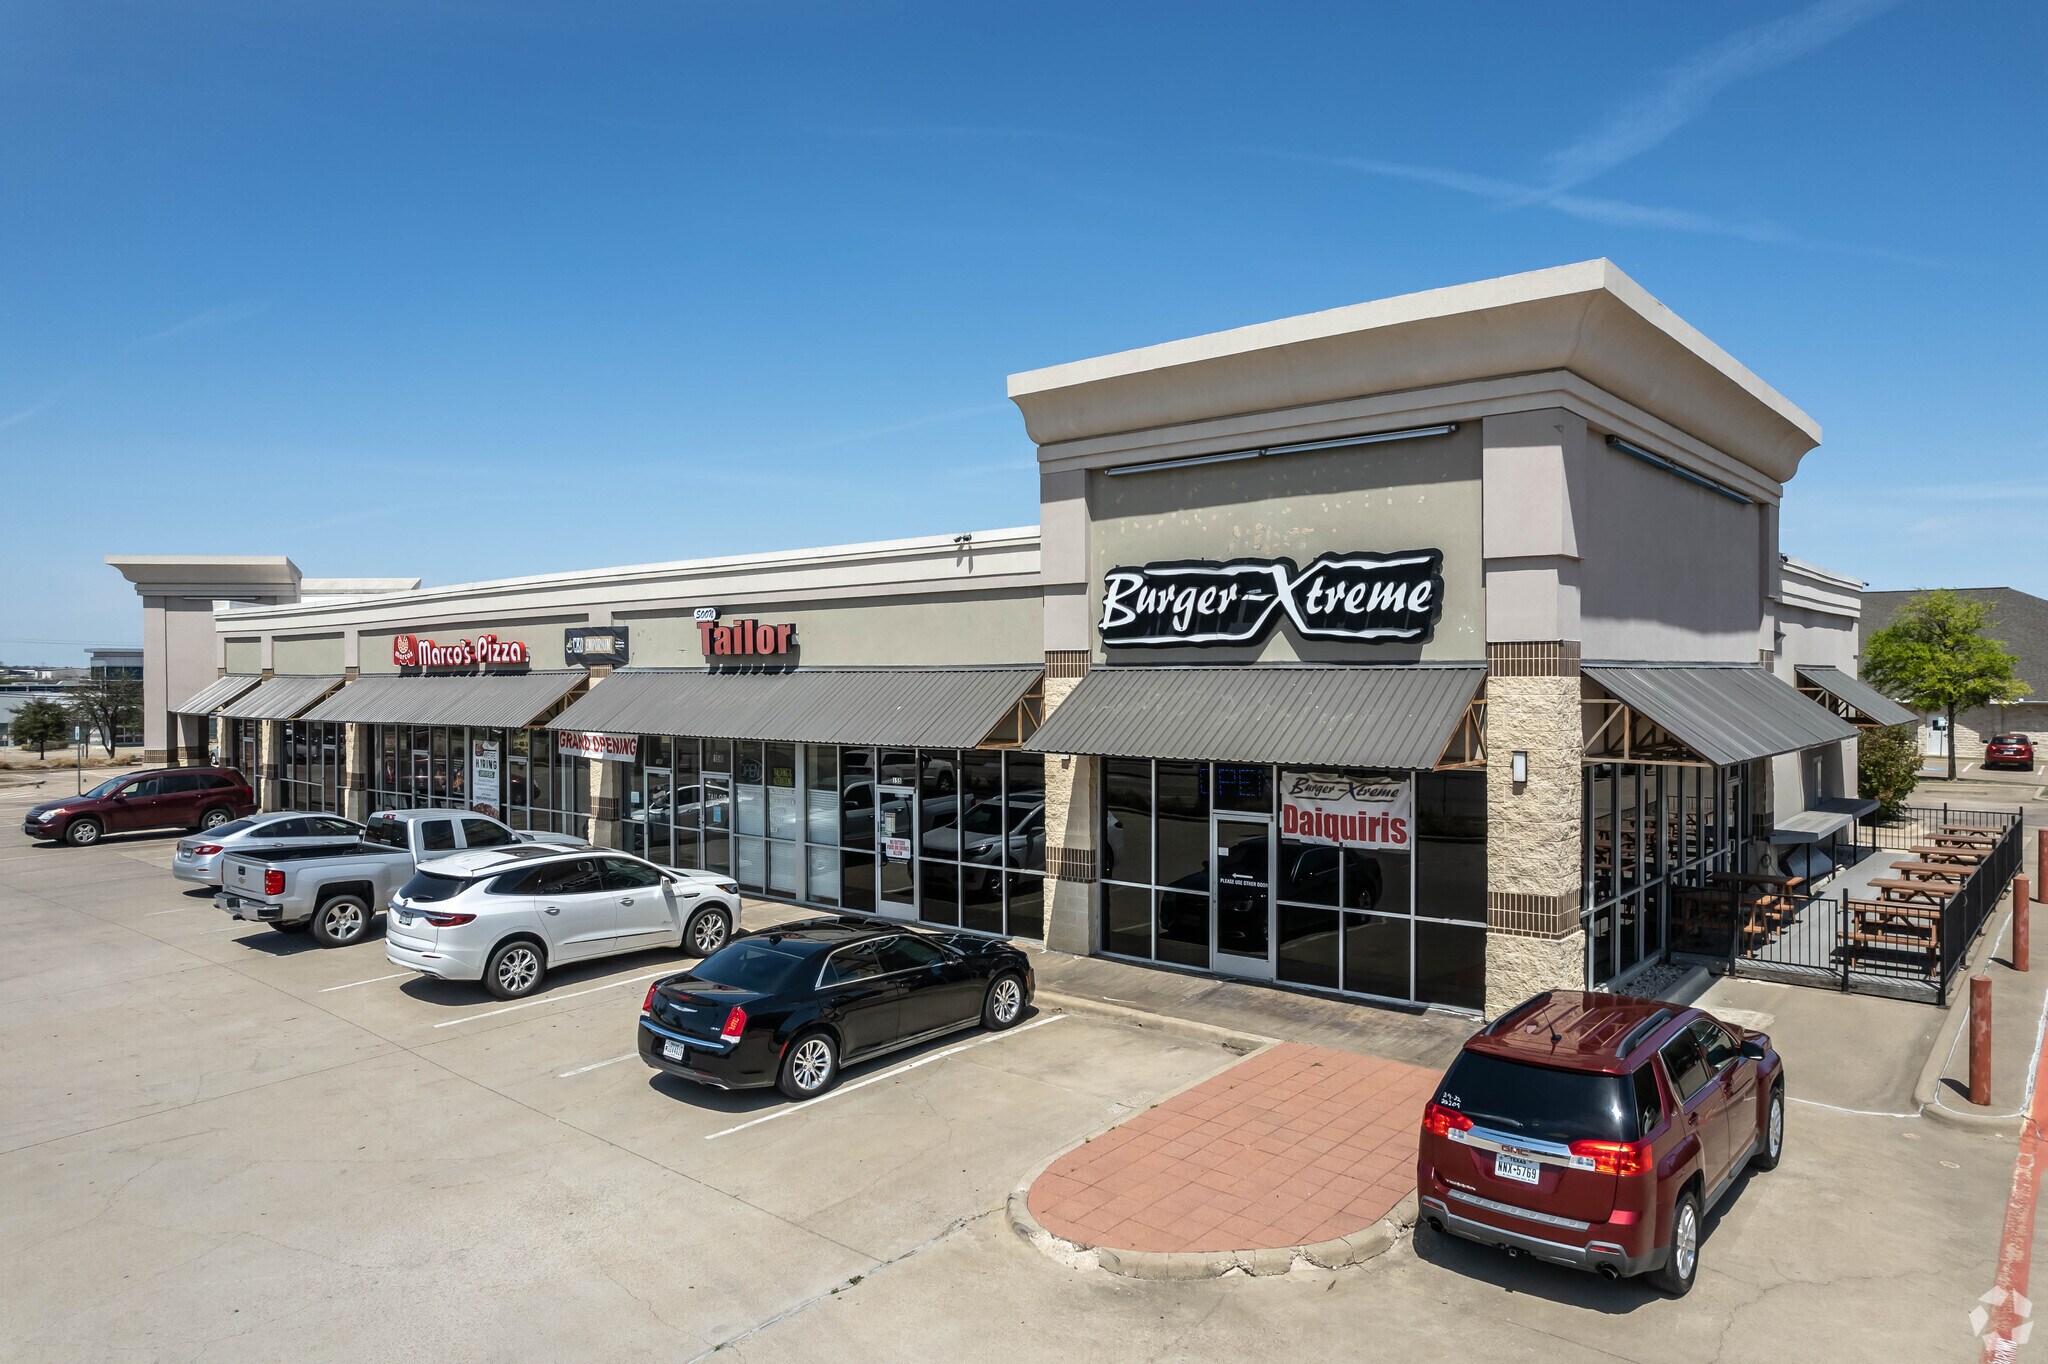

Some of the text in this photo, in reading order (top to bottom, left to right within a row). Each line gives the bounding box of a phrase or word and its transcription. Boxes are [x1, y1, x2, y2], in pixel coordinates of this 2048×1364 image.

[697, 619, 791, 655] Tailor
[418, 635, 521, 665] Marco's Pizza
[560, 731, 637, 756] GRAND OPENING
[475, 759, 498, 769] HIRING
[740, 763, 760, 778] OPEN
[1283, 804, 1408, 844] Daiquiris
[1502, 1144, 1530, 1157] GMC
[1510, 1156, 1527, 1165] TEXAS
